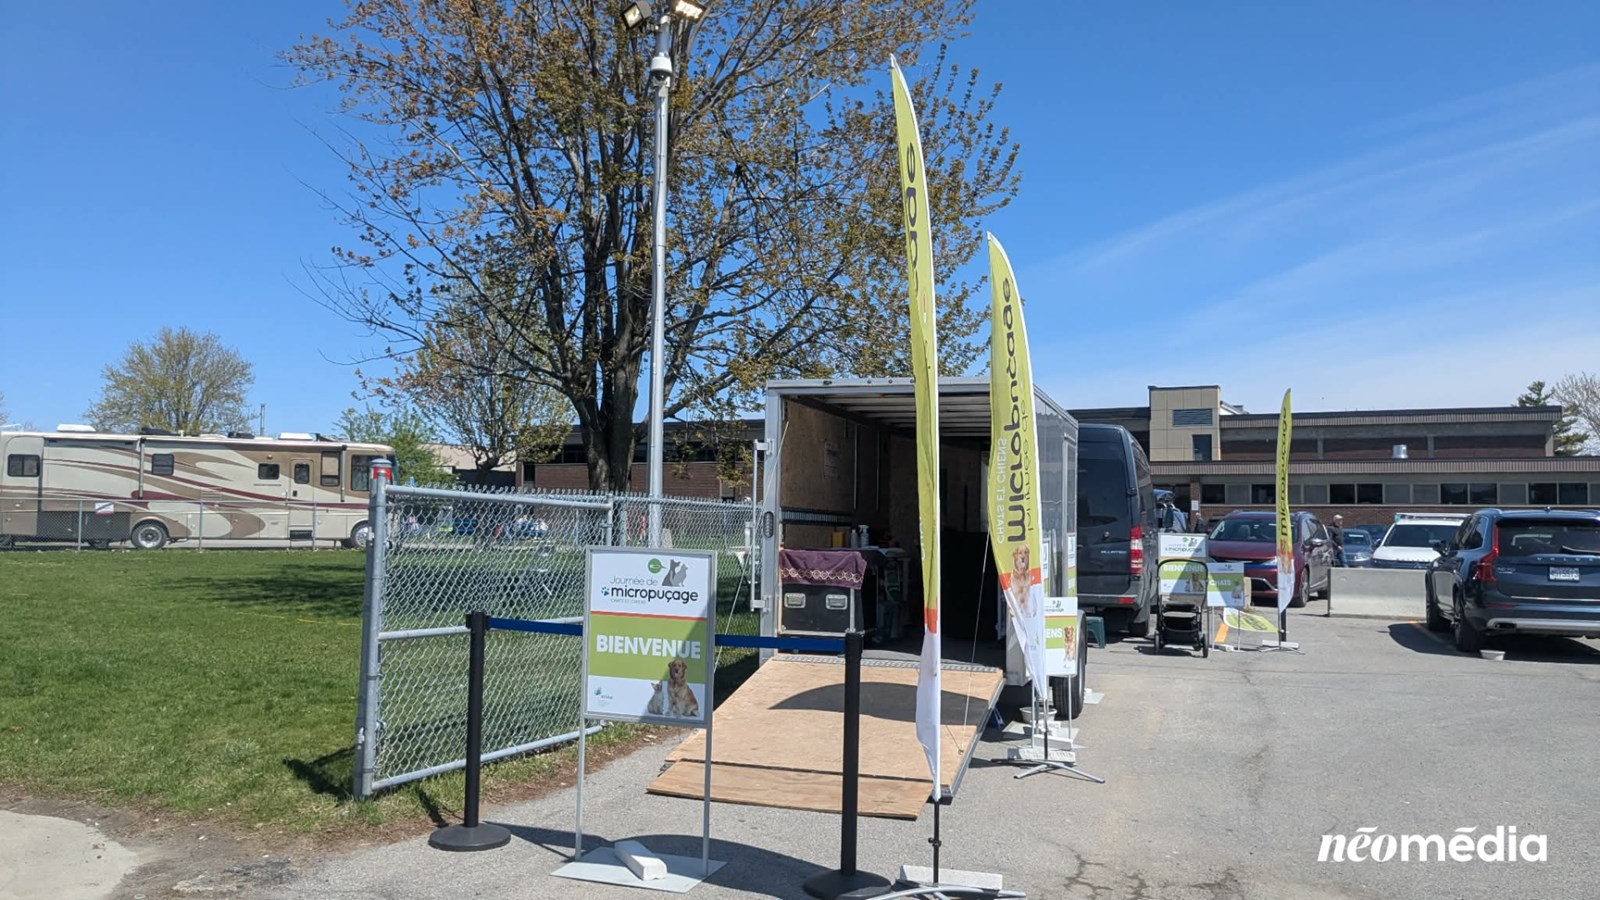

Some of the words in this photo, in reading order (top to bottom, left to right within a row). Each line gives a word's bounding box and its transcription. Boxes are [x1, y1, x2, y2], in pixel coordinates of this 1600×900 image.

[1163, 564, 1204, 572] BIENVENUE
[610, 575, 645, 586] Journée
[646, 577, 658, 586] de
[611, 585, 698, 604] micropuçage
[1046, 628, 1062, 638] ENS
[596, 634, 701, 659] BIENVENUE
